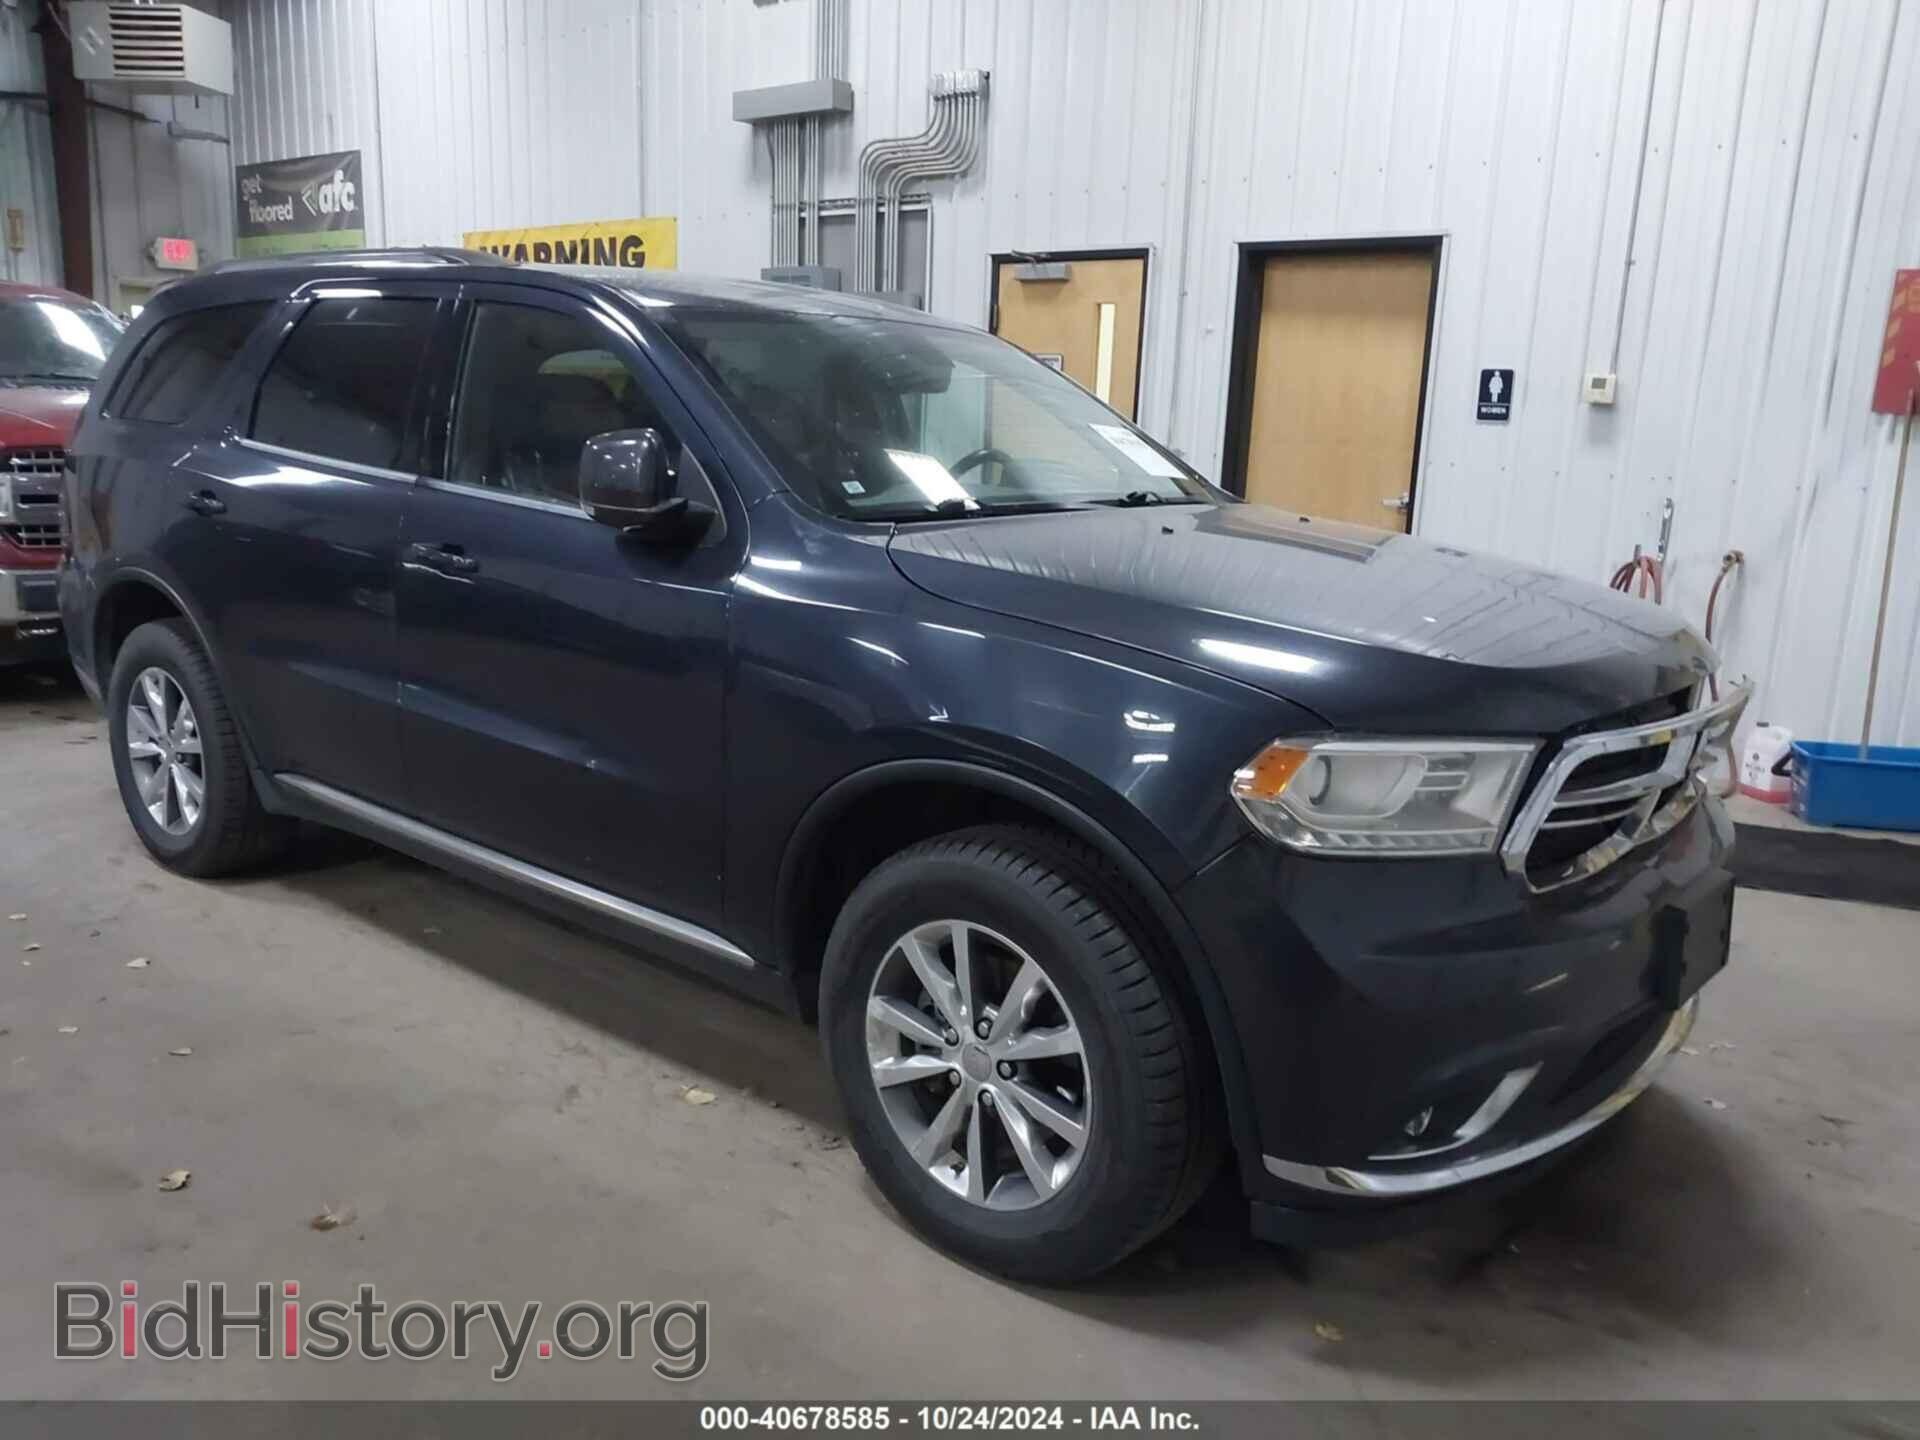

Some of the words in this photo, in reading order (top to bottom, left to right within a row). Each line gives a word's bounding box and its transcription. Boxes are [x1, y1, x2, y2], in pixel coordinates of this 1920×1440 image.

[241, 173, 262, 201] get
[319, 169, 355, 214] afc
[248, 195, 293, 223] floored
